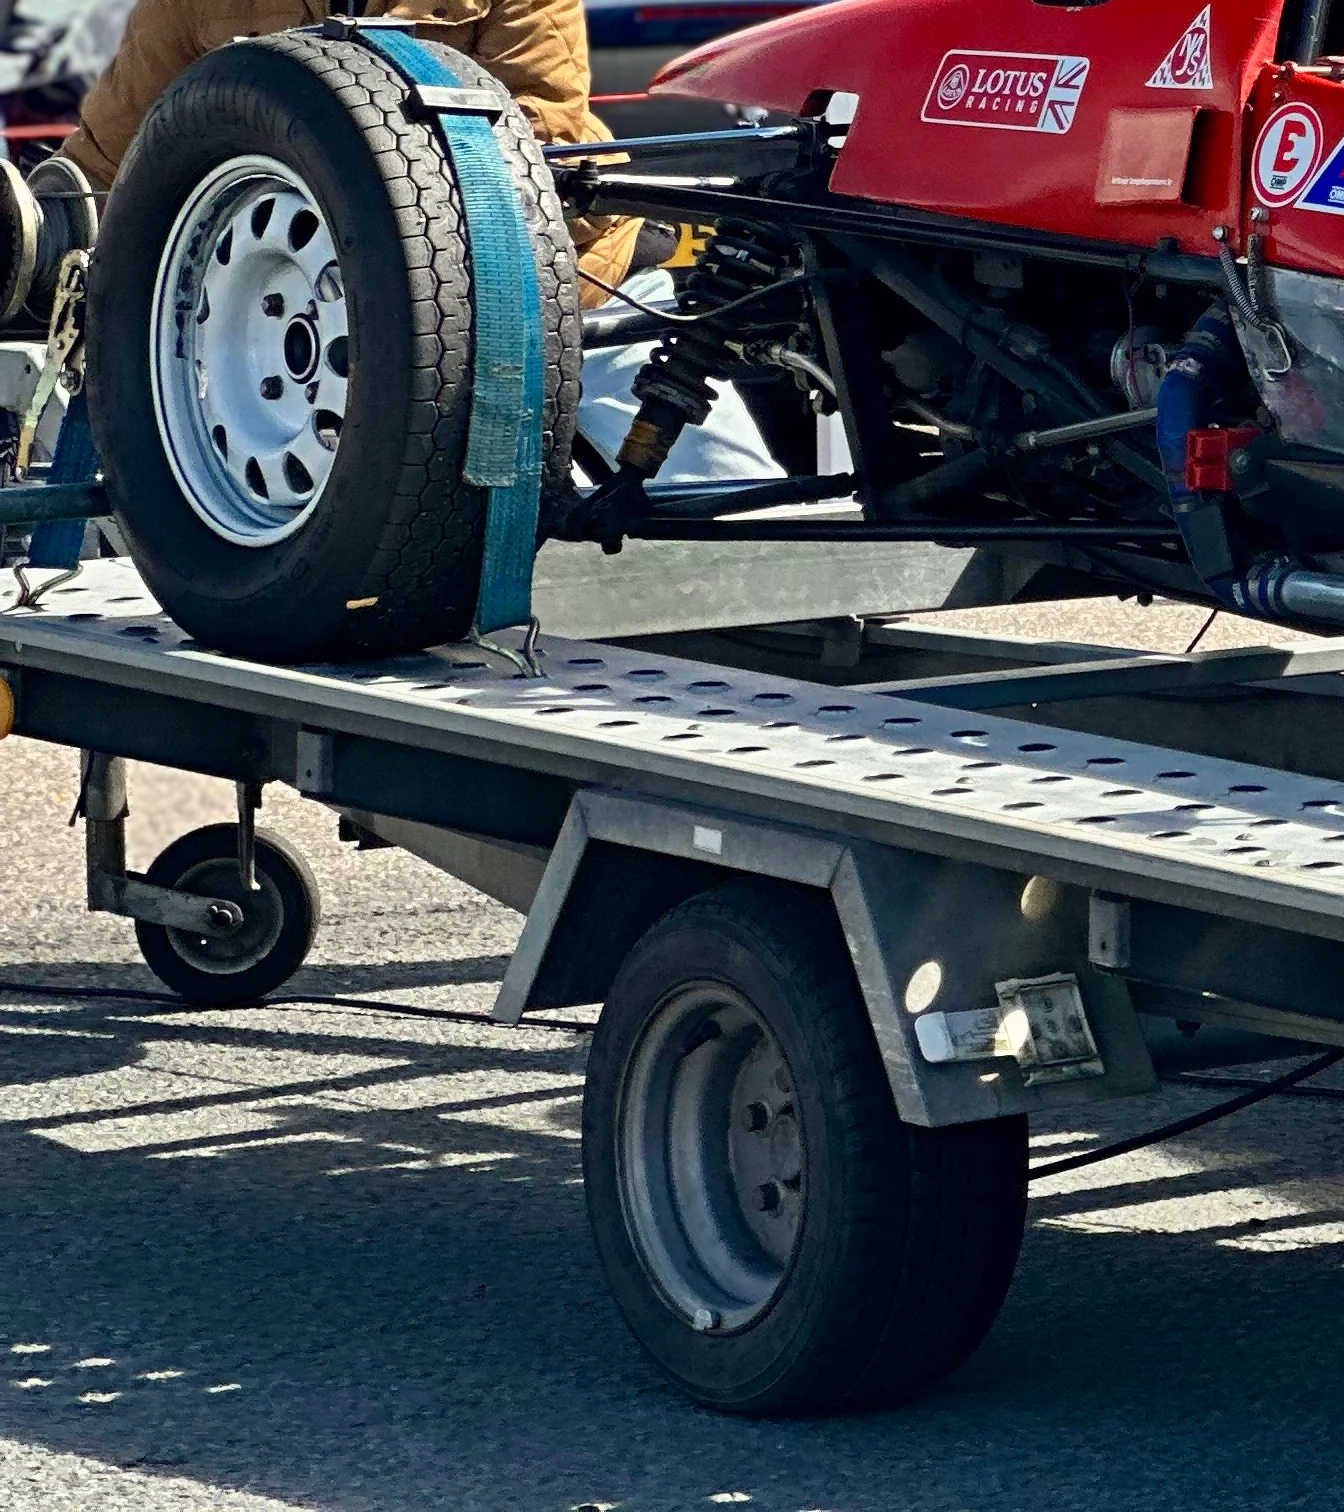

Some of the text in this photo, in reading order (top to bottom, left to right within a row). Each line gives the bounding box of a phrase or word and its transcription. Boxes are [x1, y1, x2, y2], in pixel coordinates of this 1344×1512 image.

[971, 68, 1047, 97] LOTUS
[965, 95, 1039, 114] RACING
[1272, 119, 1307, 173] E
